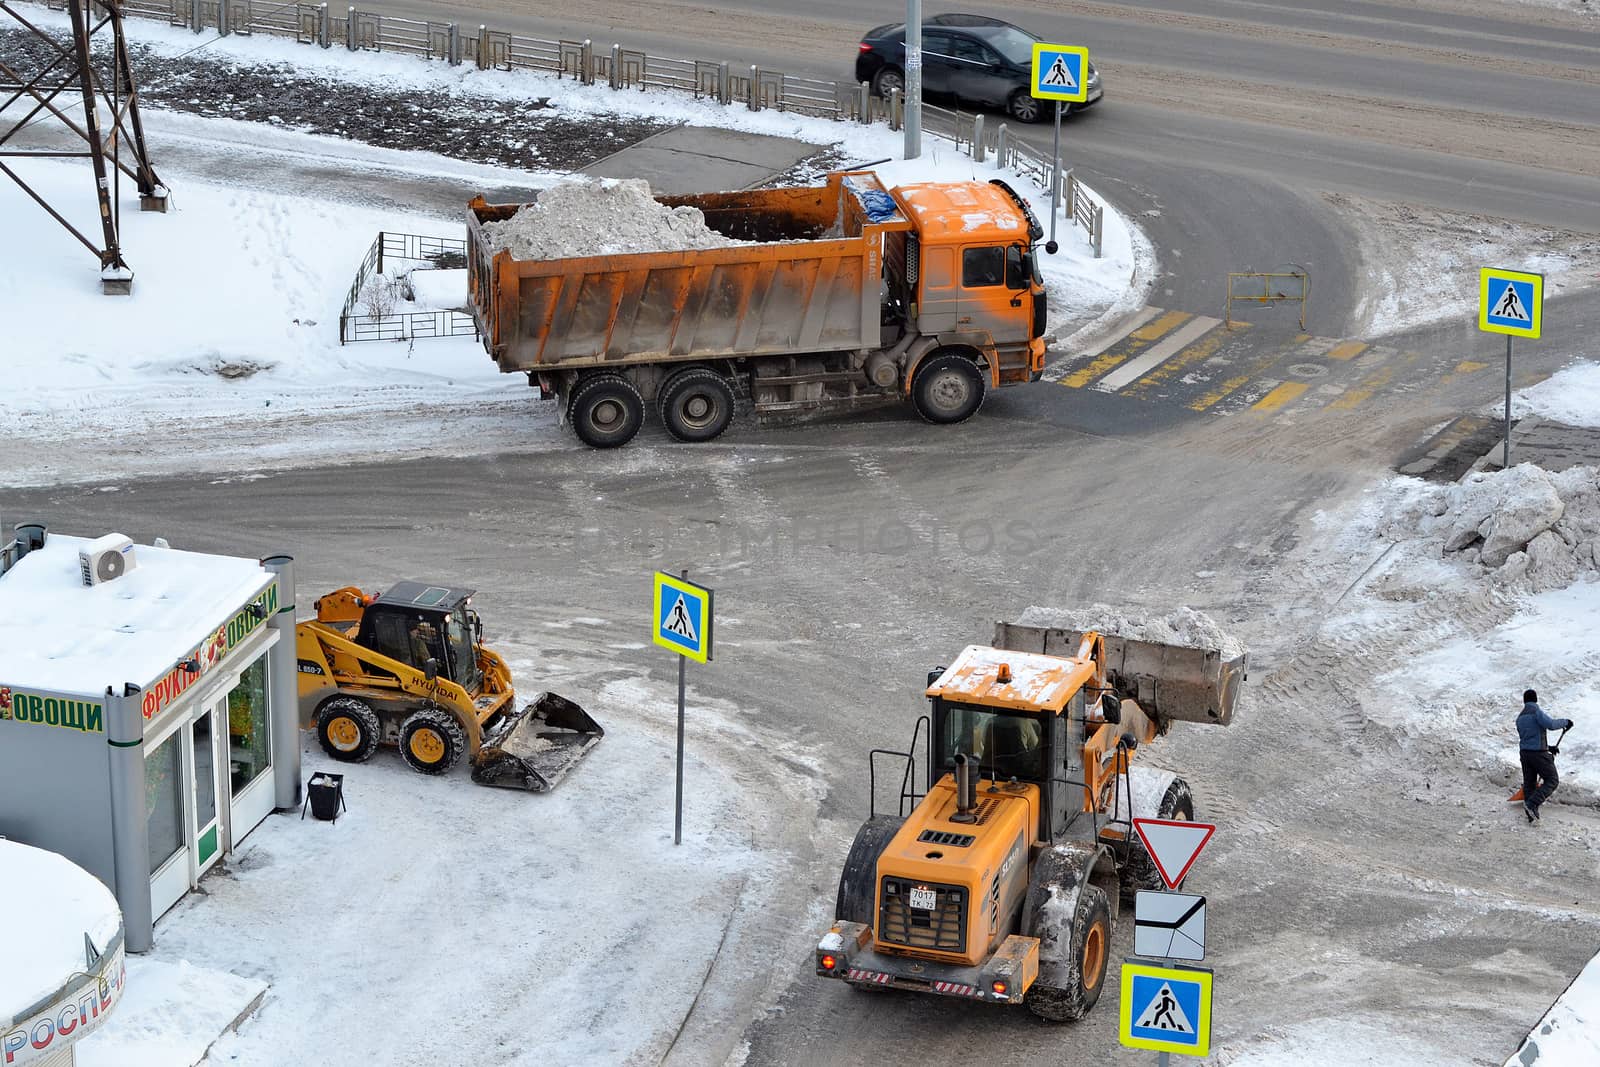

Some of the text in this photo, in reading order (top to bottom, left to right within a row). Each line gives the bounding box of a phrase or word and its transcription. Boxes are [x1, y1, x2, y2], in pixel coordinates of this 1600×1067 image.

[412, 676, 458, 701] HYUNDAI
[13, 692, 104, 733] ОВОЩИ
[913, 890, 933, 900] 7017
